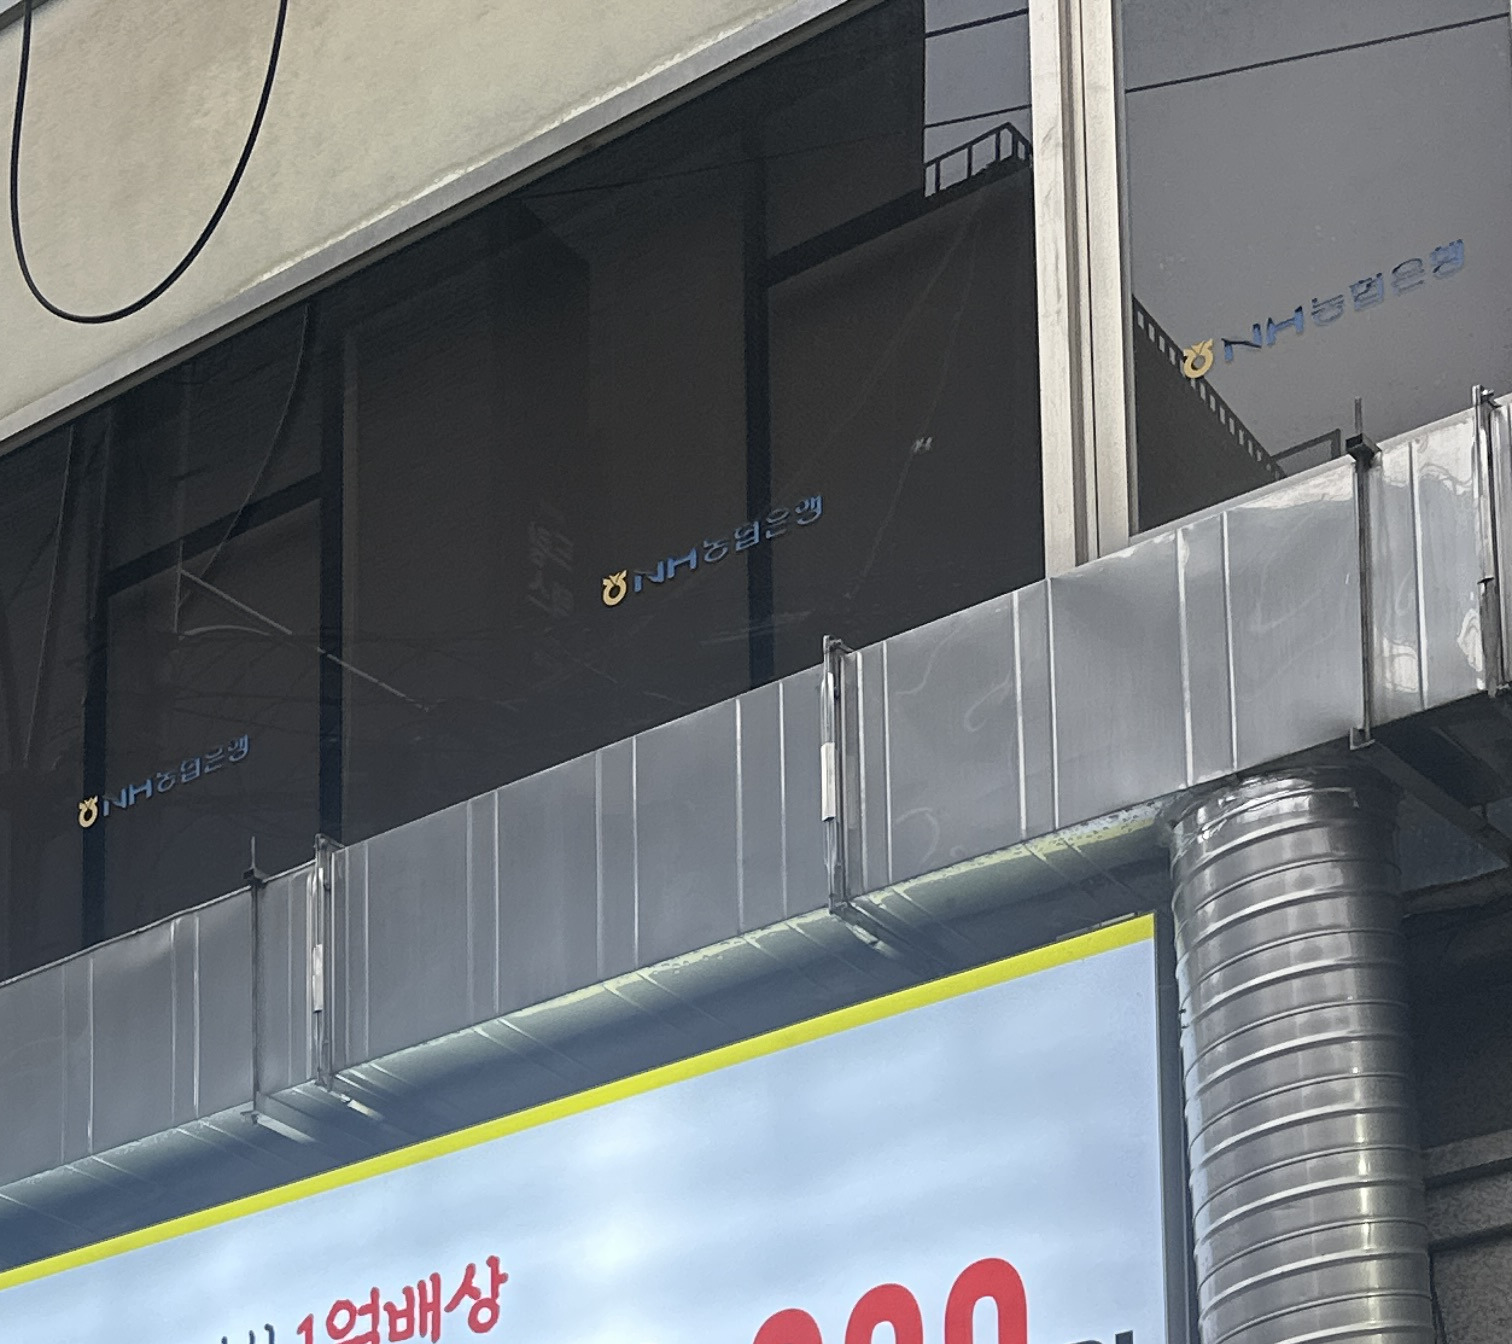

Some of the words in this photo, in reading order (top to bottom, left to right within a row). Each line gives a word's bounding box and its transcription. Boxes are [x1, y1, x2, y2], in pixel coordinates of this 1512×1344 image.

[1221, 238, 1465, 362] NH농협은행
[633, 493, 824, 594] NH농협은행
[102, 734, 250, 818] NH농협은행
